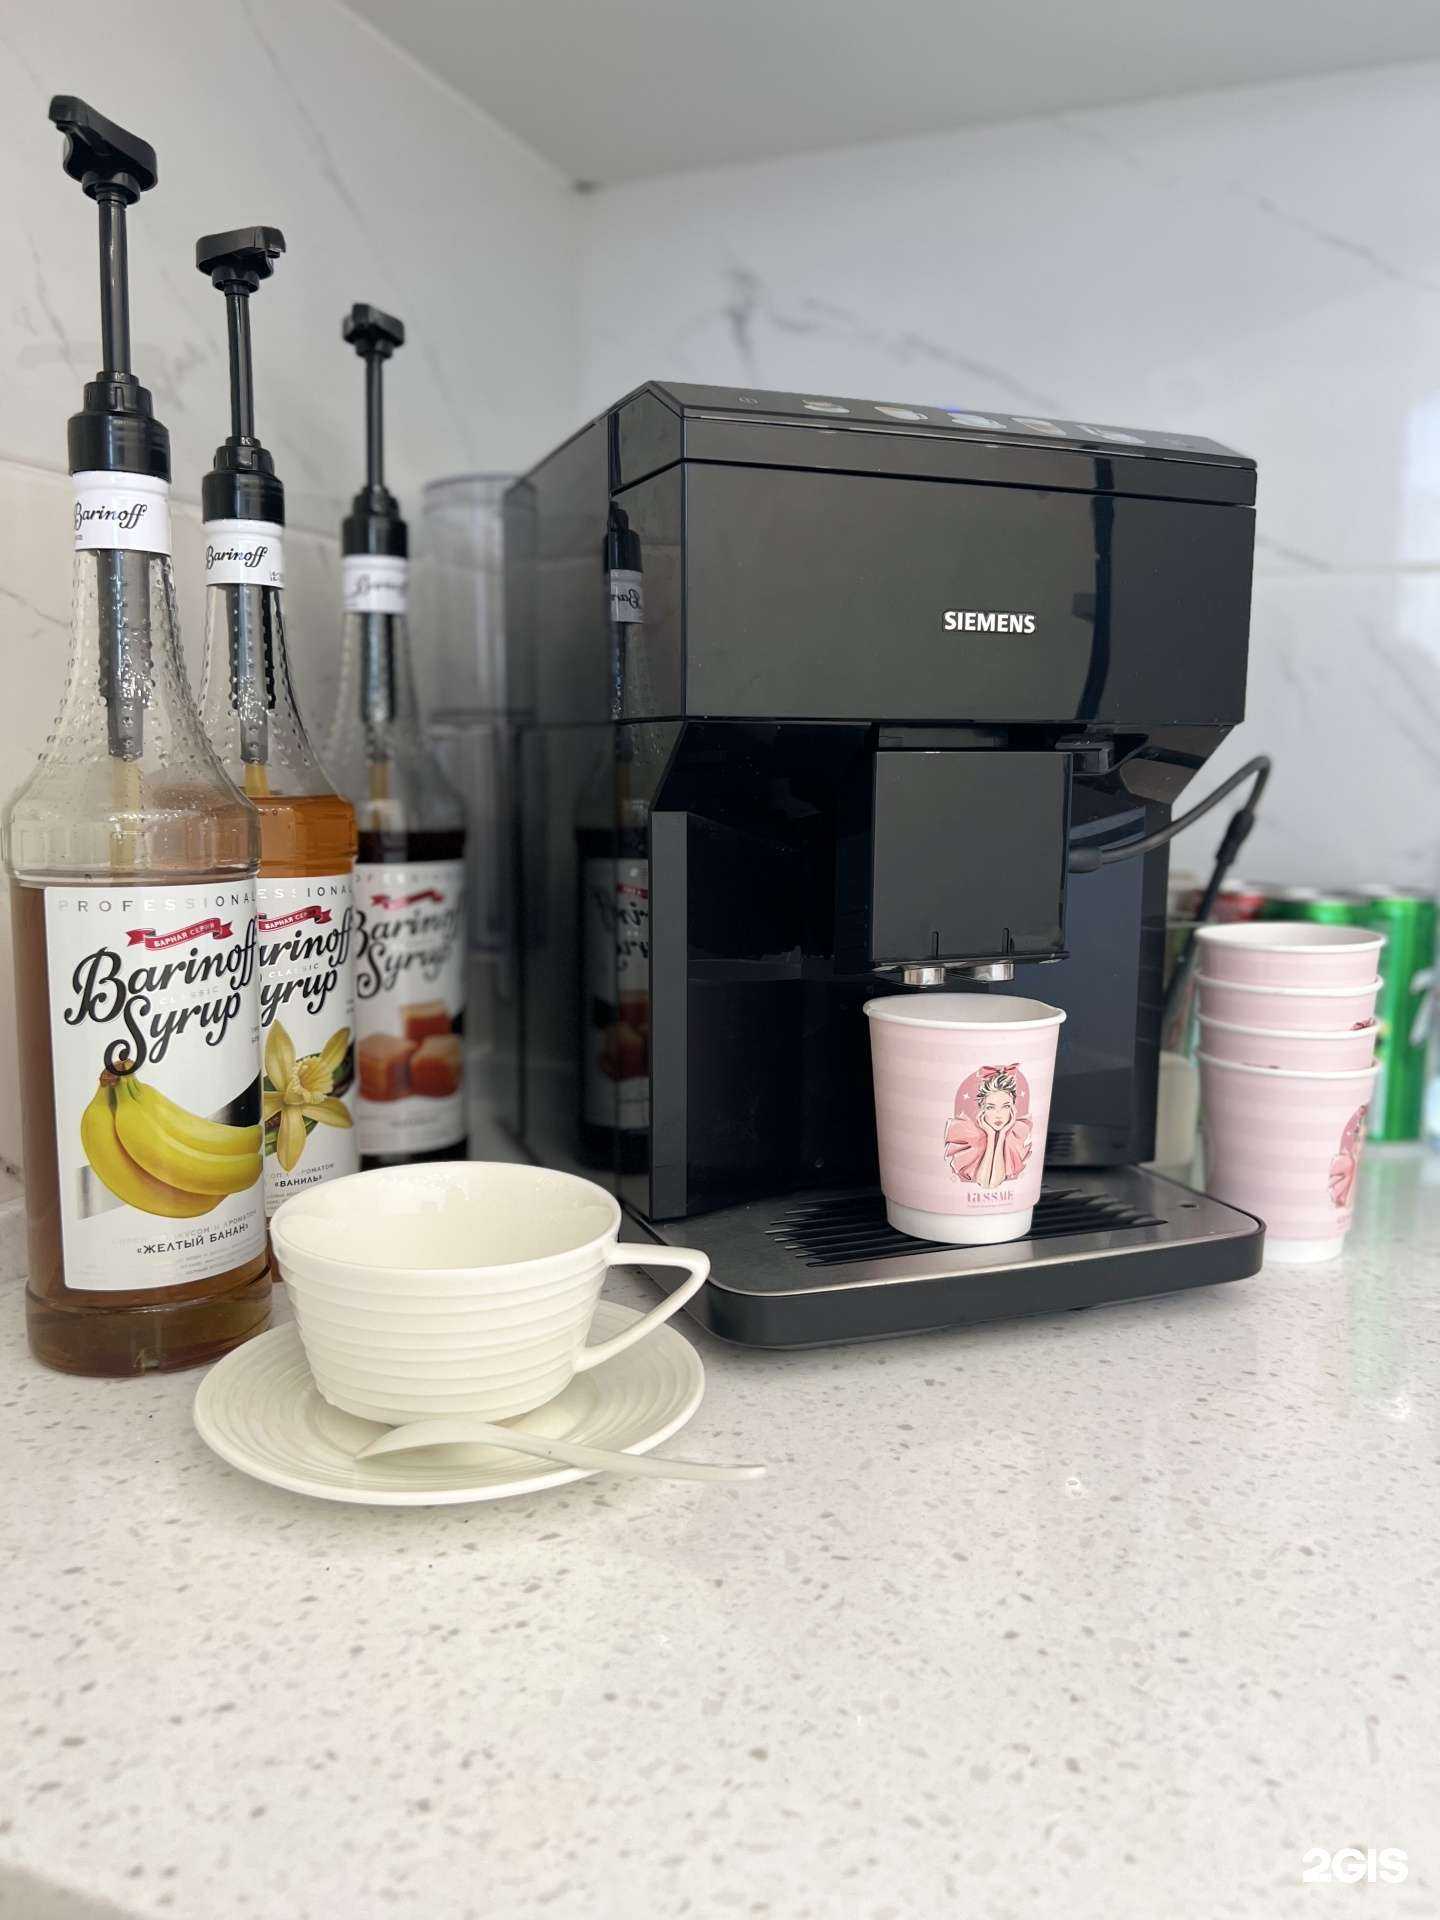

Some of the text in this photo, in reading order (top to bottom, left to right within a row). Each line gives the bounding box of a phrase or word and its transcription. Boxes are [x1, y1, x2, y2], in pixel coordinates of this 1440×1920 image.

[74, 501, 148, 531] Barinoff
[206, 545, 269, 570] Barinoff
[943, 611, 1036, 634] SIEMENS
[64, 916, 258, 1025] Barinoff
[260, 968, 337, 1027] yrup
[104, 993, 241, 1076] Syrup
